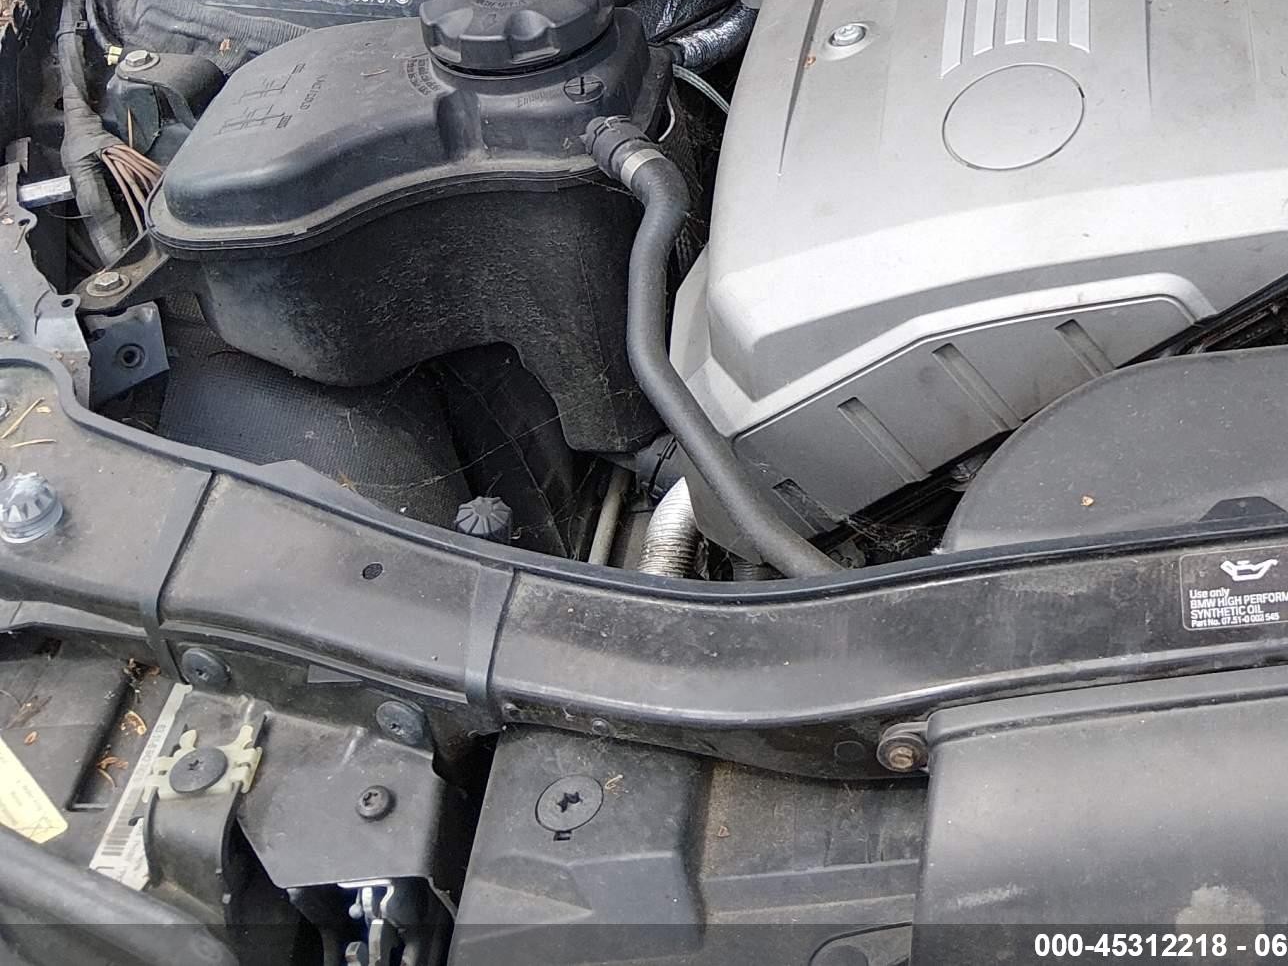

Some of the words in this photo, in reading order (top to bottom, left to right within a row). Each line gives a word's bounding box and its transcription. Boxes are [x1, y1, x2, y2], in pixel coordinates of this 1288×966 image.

[1189, 589, 1208, 599] Use
[1209, 587, 1230, 598] only
[1190, 598, 1216, 609] BMW
[1218, 595, 1242, 607] HIGH
[1191, 606, 1246, 619] SYNTHETIC
[1247, 605, 1264, 613] OIL
